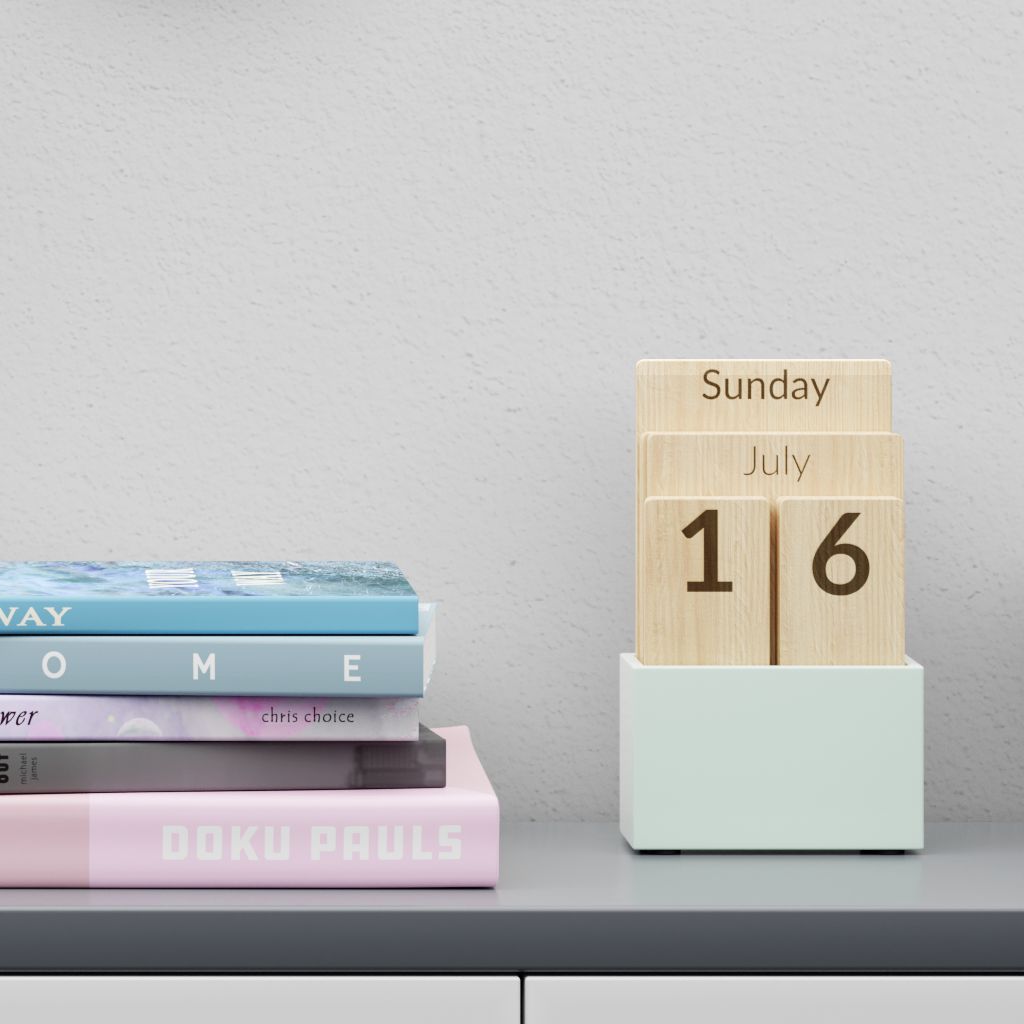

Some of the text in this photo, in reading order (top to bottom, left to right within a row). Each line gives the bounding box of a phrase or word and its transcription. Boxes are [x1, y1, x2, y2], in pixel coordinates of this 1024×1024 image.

[702, 369, 830, 406] Sunday
[743, 446, 811, 482] July
[261, 707, 355, 723] chris choice
[162, 824, 462, 861] DOKU PAULS
